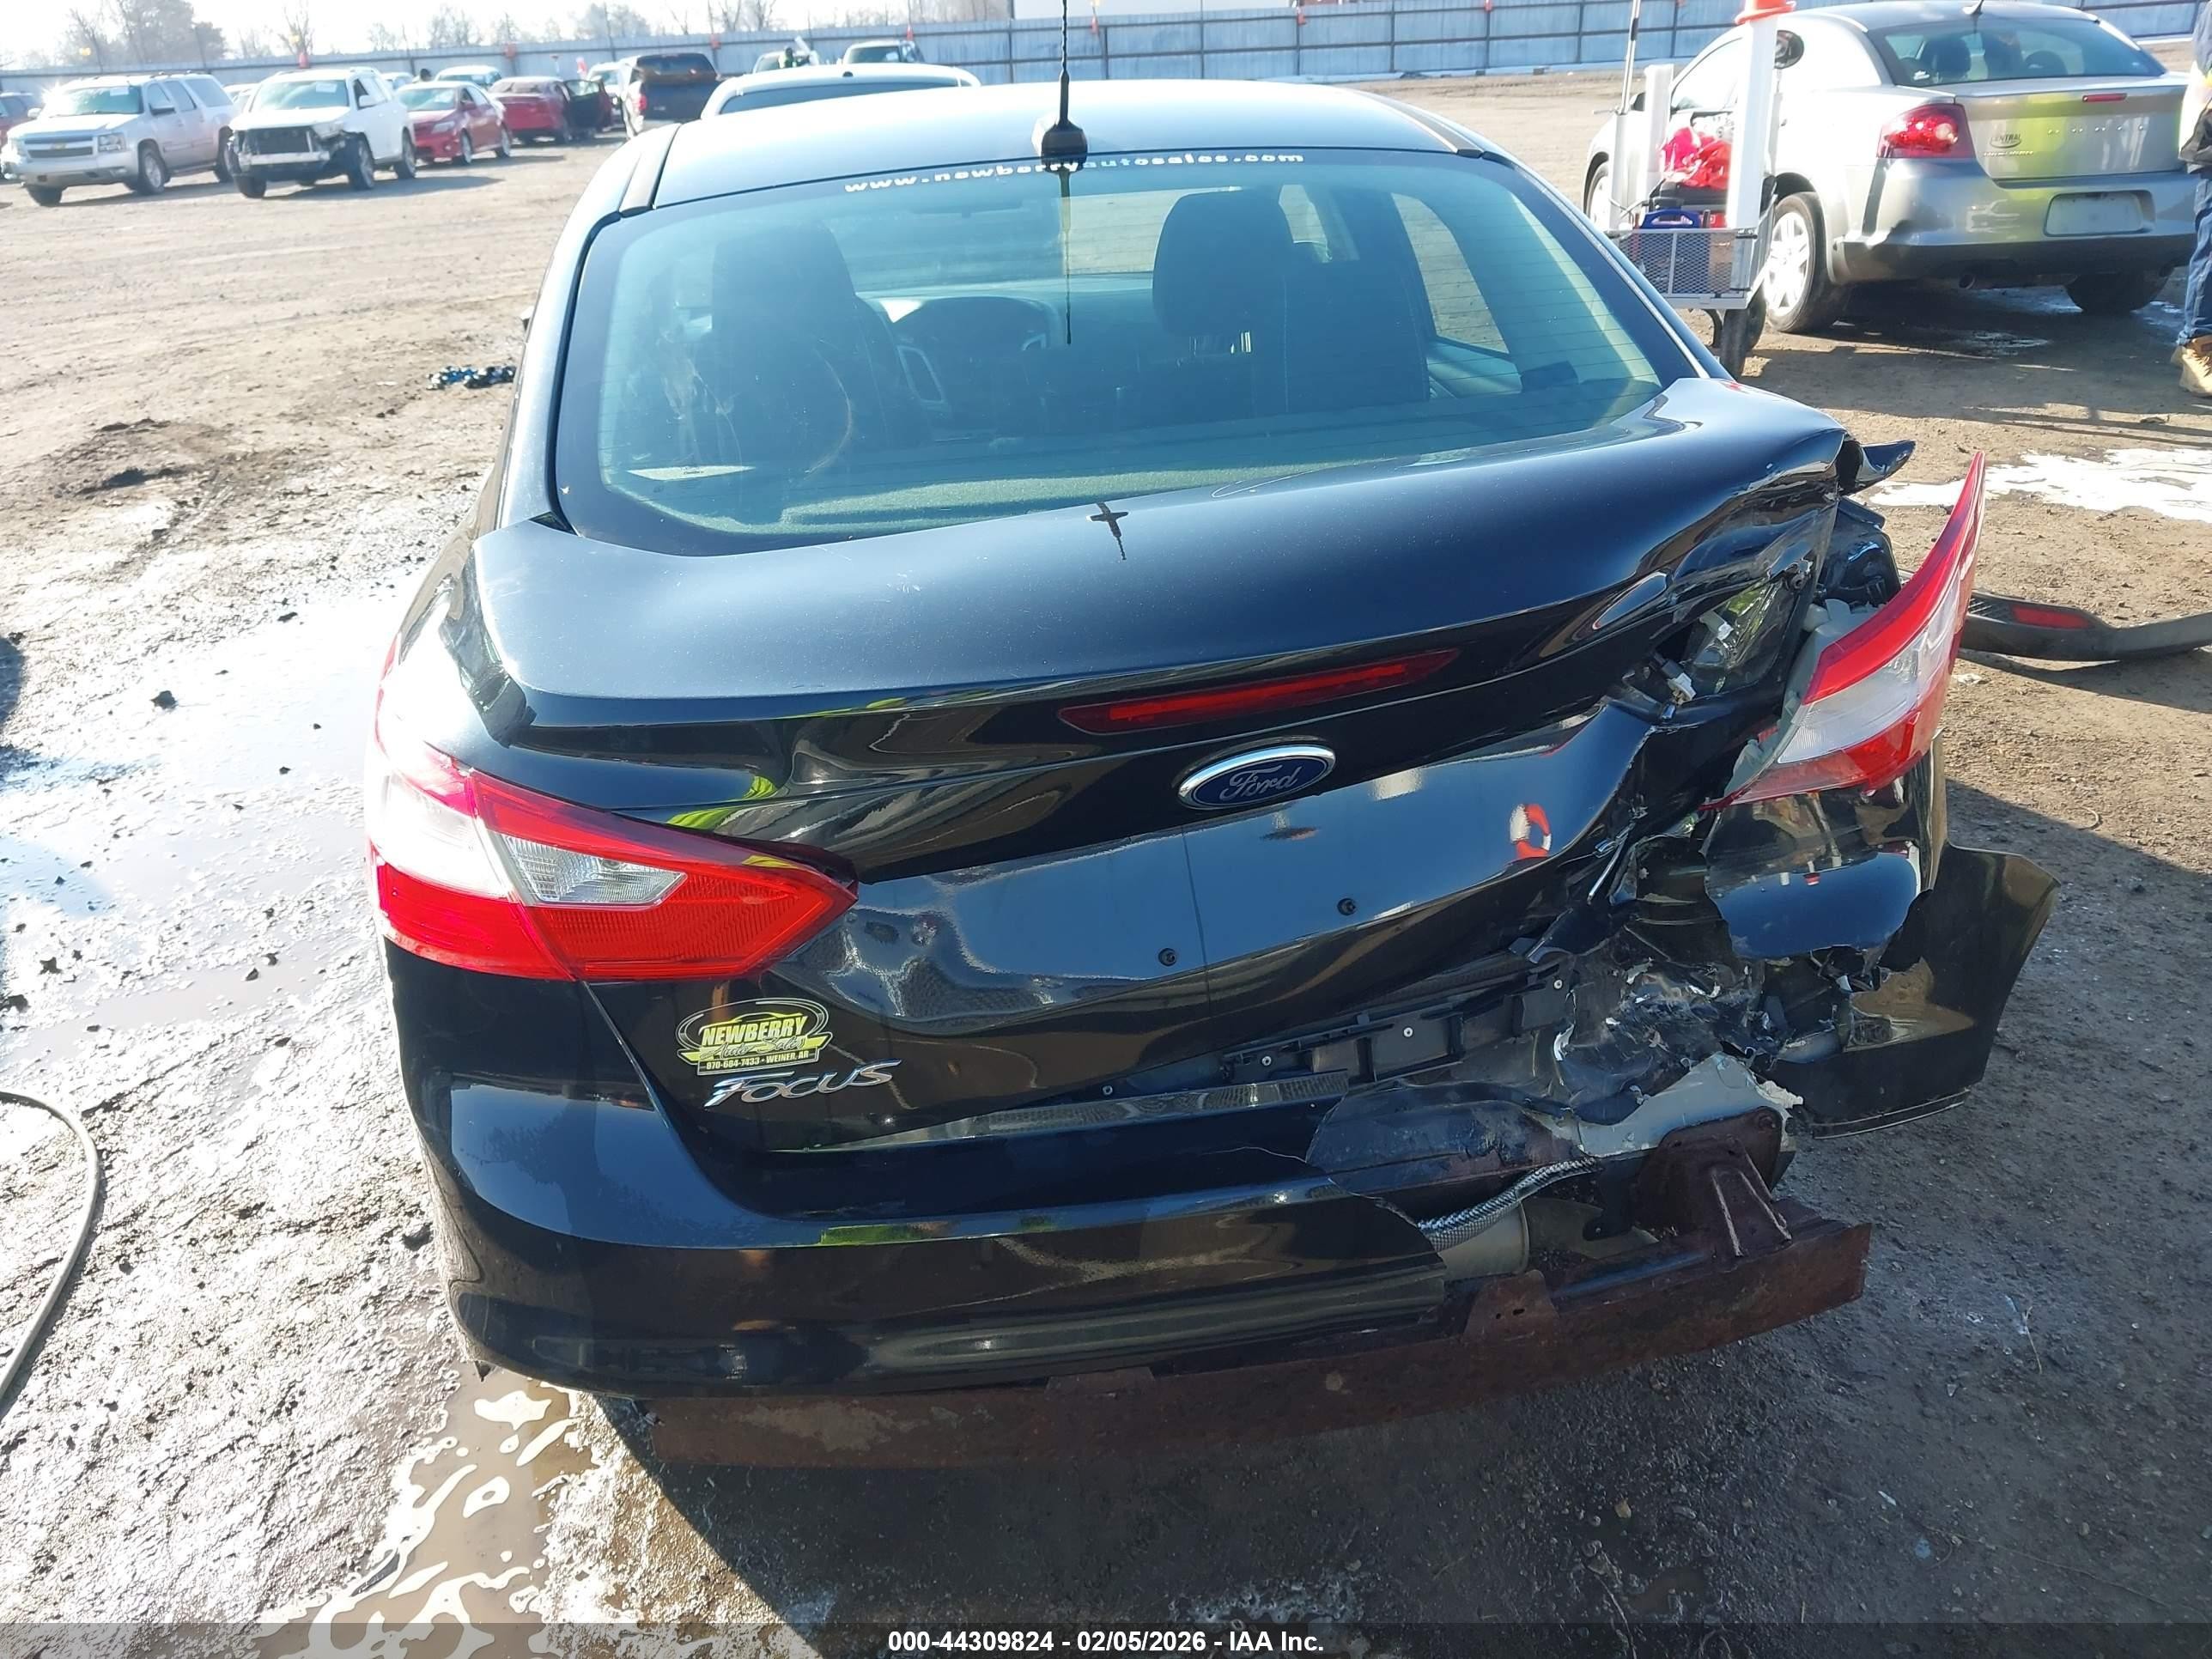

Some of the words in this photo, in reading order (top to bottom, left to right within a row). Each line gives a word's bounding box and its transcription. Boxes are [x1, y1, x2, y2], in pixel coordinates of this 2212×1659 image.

[844, 153, 1304, 191] www.newberryautosales.com
[1218, 764, 1303, 801] Ford
[702, 1015, 809, 1046] NEWBERRY
[700, 1042, 752, 1060] Auto
[756, 1035, 806, 1054] Sales
[798, 1050, 810, 1060] AR
